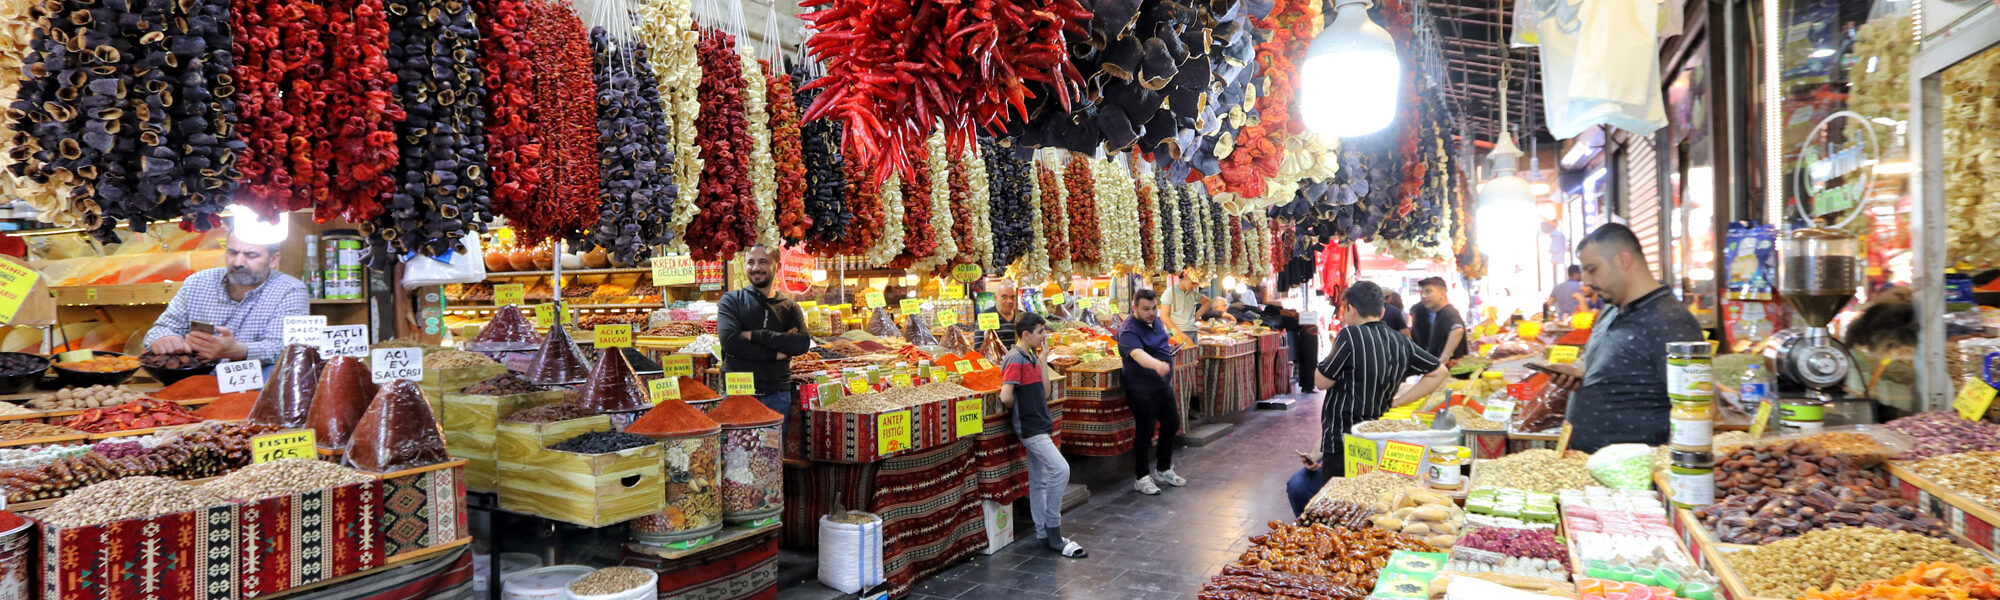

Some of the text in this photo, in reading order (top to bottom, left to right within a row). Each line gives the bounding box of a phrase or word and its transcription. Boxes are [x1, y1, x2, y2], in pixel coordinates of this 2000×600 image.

[322, 327, 363, 340] TATLI
[333, 338, 351, 348] EV
[384, 350, 408, 361] ACI
[389, 360, 410, 369] EV
[229, 375, 247, 387] 45
[655, 380, 674, 390] ÖZEL
[883, 414, 905, 427] ANTEP
[960, 412, 979, 423] FISTIK
[259, 435, 307, 448] FISTIK
